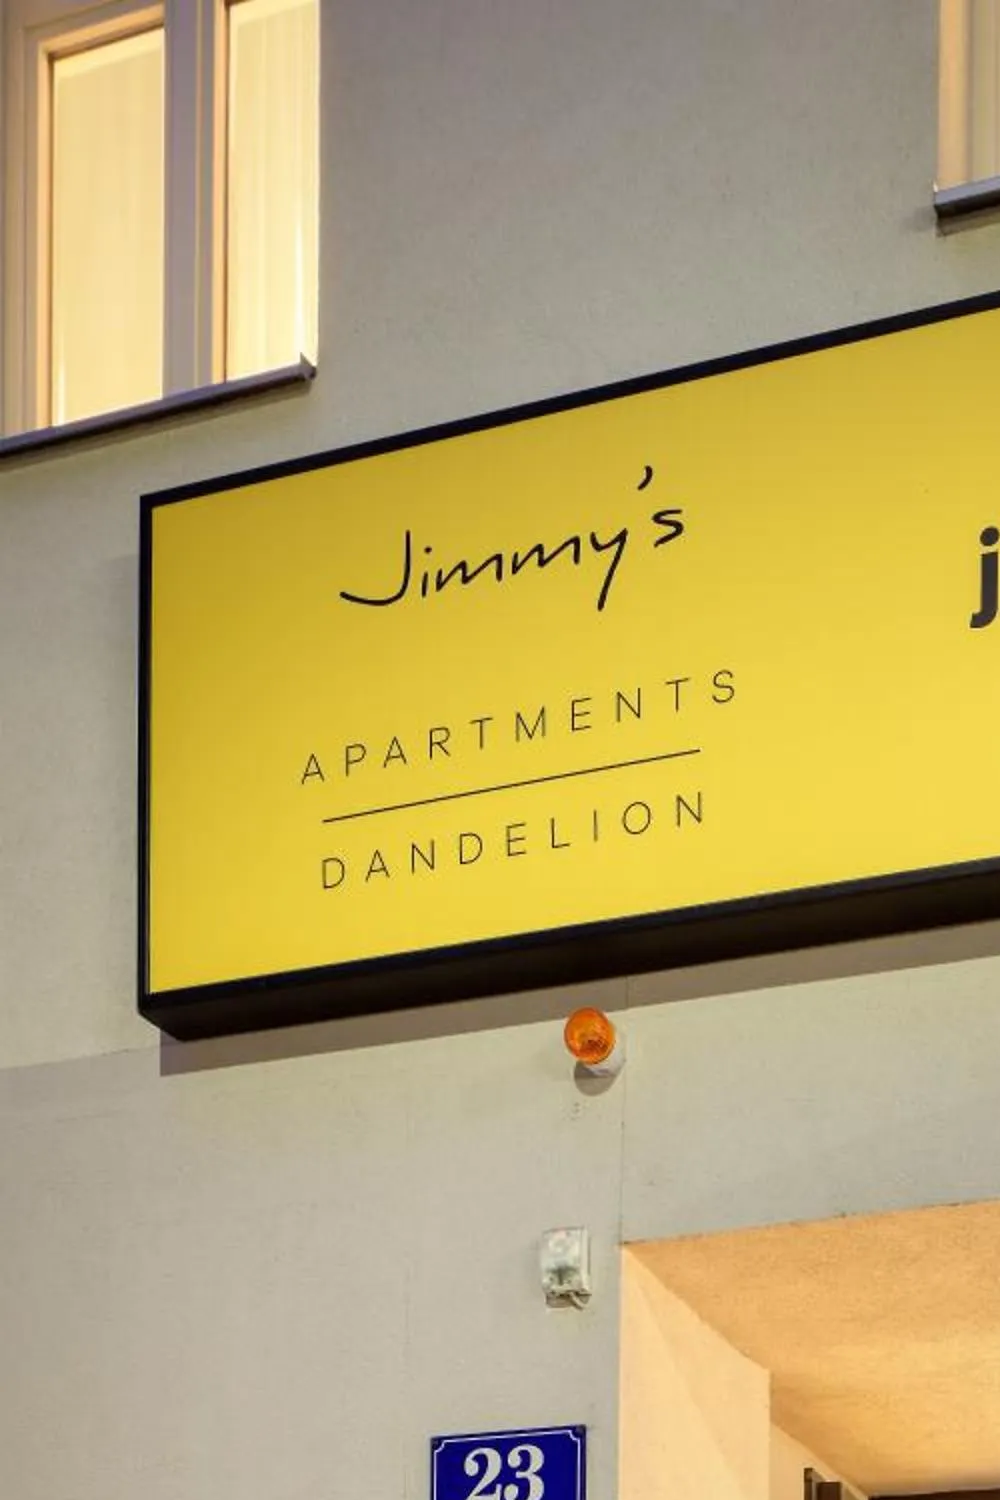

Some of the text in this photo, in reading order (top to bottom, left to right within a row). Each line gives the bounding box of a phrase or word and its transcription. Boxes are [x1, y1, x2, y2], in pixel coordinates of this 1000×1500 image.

[340, 465, 684, 611] Jimmy's
[301, 669, 736, 785] APARTMENTS
[321, 791, 703, 889] DANDELION
